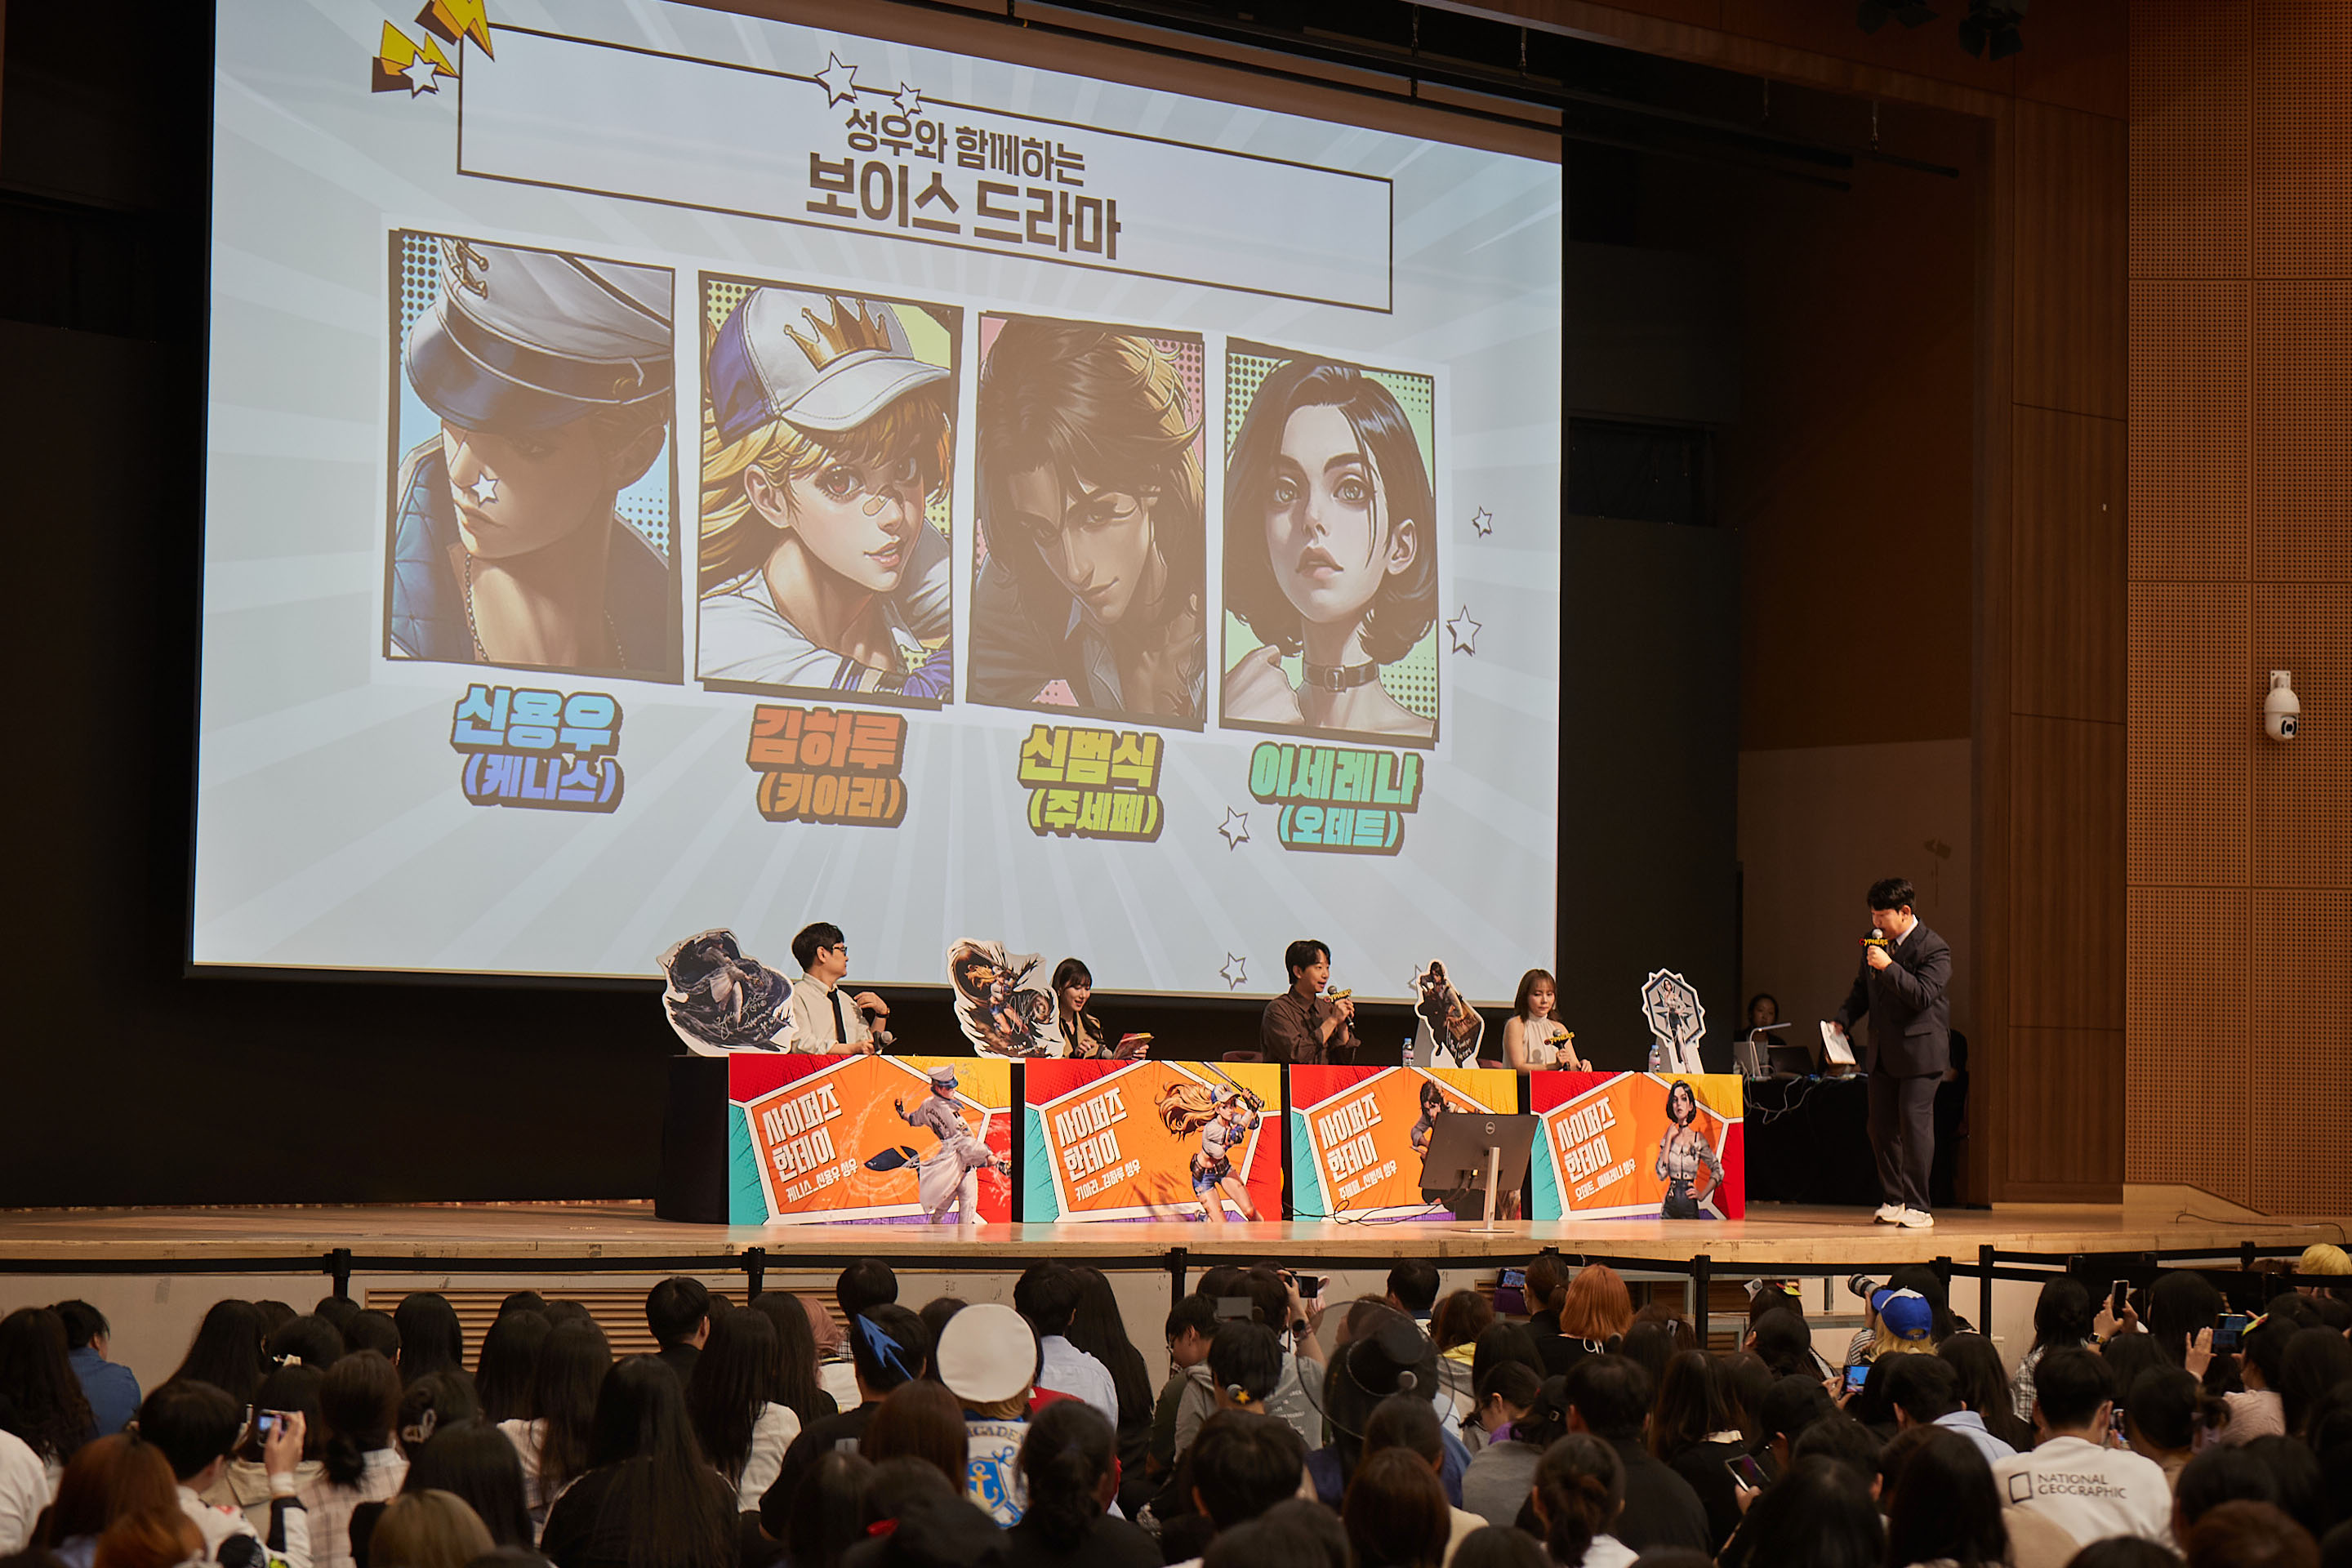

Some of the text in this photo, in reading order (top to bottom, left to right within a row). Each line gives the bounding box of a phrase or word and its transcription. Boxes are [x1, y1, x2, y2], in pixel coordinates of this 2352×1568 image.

[846, 109, 1085, 187] 성우와 함께하는
[806, 152, 1121, 260] 보이스 드라마
[452, 686, 621, 754] 신용우
[747, 706, 905, 771] 김하루
[463, 752, 621, 807] (케니스)
[1019, 726, 1160, 789] 신범식
[1249, 742, 1421, 806] 이세레나
[758, 771, 904, 820] (키아라)
[1029, 787, 1160, 835] (주세페)
[1280, 804, 1401, 849] (오데트)
[762, 1083, 842, 1147] 사이퍼즈
[1054, 1087, 1128, 1147] 사이퍼즈
[1318, 1092, 1383, 1151] 사이퍼즈
[1556, 1096, 1616, 1152] 사이퍼즈
[772, 1127, 836, 1183] 한데이
[840, 1158, 858, 1177] 성우
[1063, 1129, 1122, 1183] 한데이
[1125, 1159, 1141, 1177] 성우
[1327, 1131, 1379, 1183] 한데이
[1383, 1160, 1397, 1178] 성우
[1564, 1134, 1613, 1184] 한데이
[1623, 1158, 1636, 1175] 성우
[2038, 1473, 2109, 1485] NATIONAL
[2038, 1484, 2127, 1499] GEOGRAPHIC
